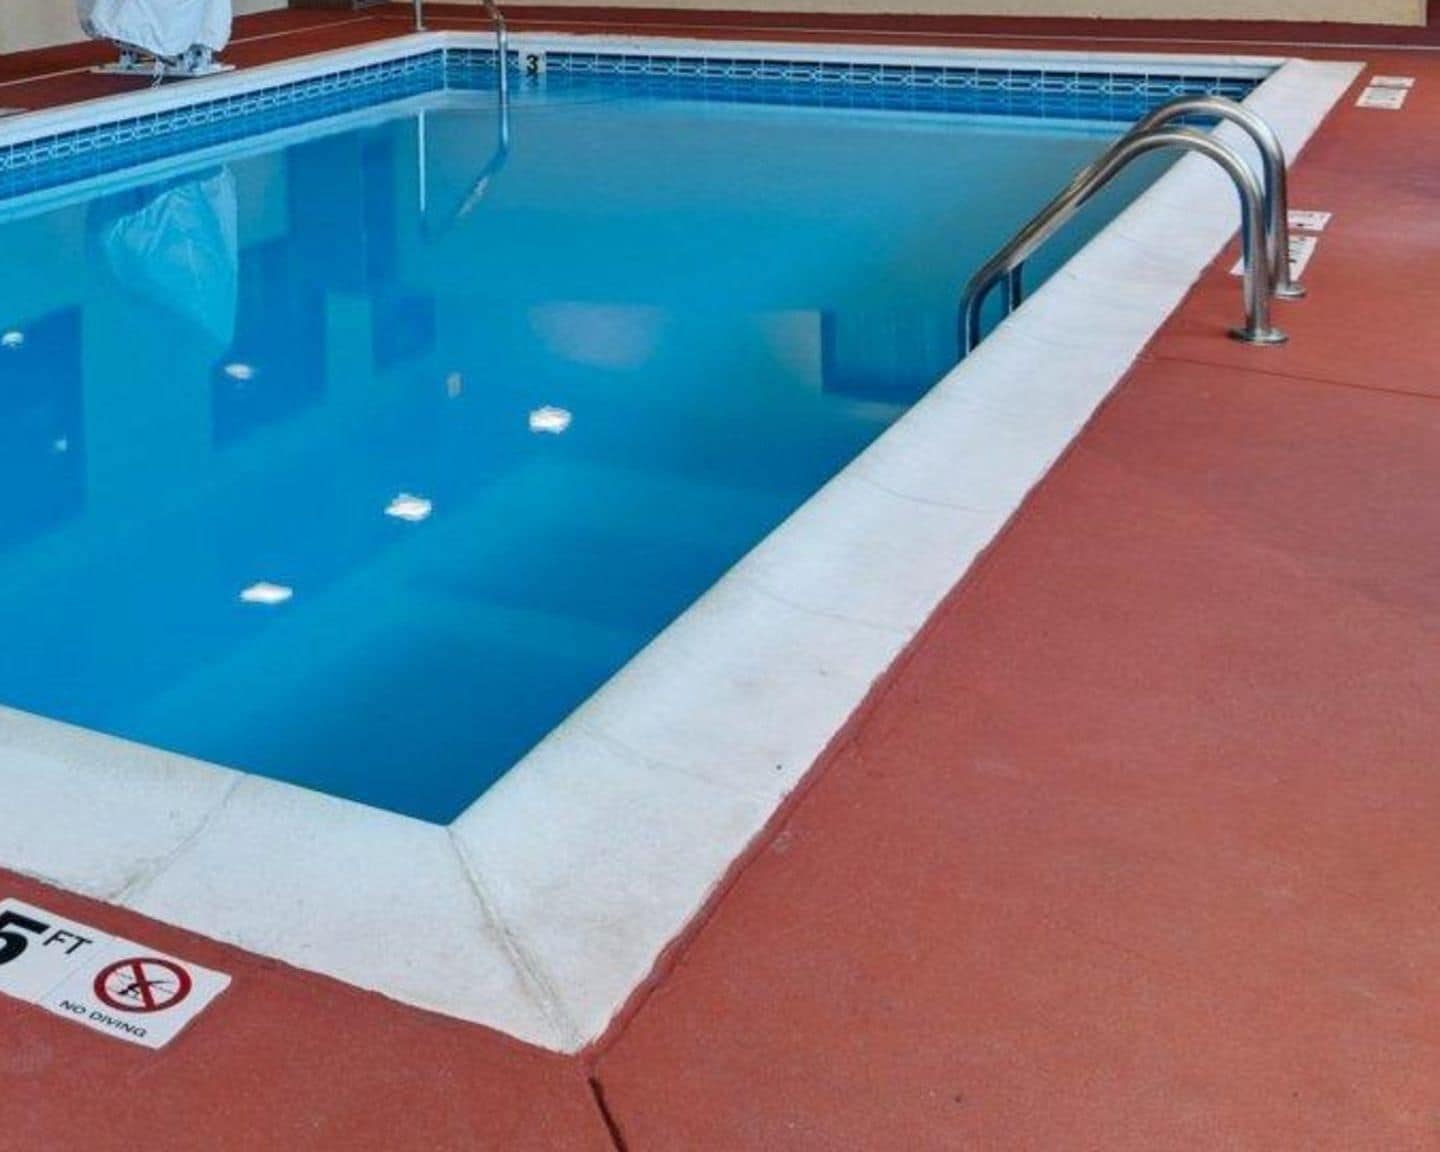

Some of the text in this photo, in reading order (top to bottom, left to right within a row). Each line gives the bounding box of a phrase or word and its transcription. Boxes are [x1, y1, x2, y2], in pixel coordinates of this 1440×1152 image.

[526, 54, 539, 73] 3
[42, 929, 93, 955] FT
[60, 1000, 147, 1038] NO DIVING
